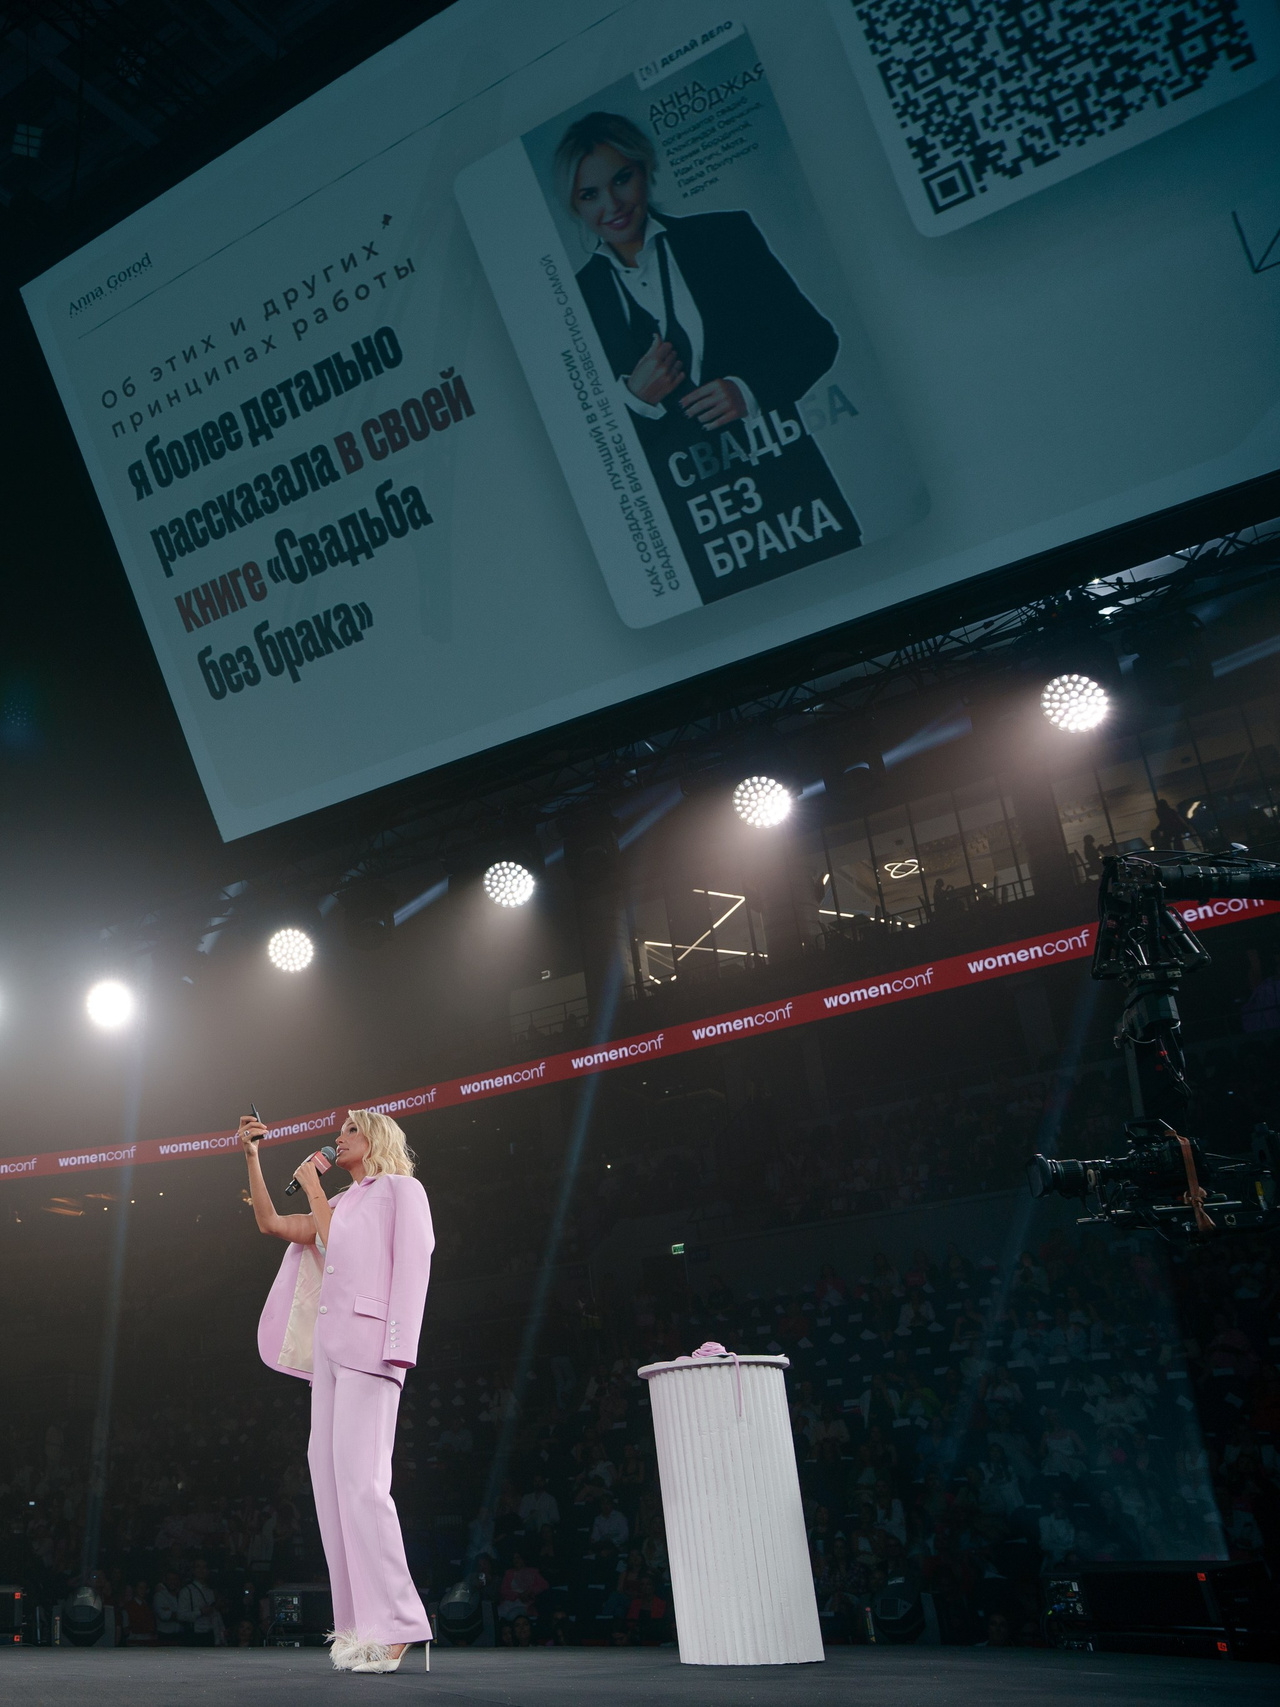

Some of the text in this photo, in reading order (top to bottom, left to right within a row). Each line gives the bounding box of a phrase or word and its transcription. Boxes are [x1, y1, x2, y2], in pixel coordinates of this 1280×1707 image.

[661, 20, 732, 68] ДЕЛАЙ ДЕЛО
[648, 80, 707, 121] АННА
[69, 252, 152, 316] Anna Gorod
[101, 241, 380, 410] Об этих и других
[111, 258, 416, 439] принципах работы
[127, 326, 404, 502] я более детально
[539, 254, 680, 591] СВАДЕБНЫЙ БИЗНЕС И НЕ РАЗВЕСТИСЬ САМОЙ
[149, 366, 476, 579] рассказала в своей
[561, 350, 666, 597] КАК СОЗДАТЬ ЛУЧШИЙ В РОССИИ
[686, 476, 763, 535] БЕЗ
[174, 478, 434, 634] книге «Свадьба
[703, 498, 843, 579] БРАКА
[196, 600, 375, 701] без брака»
[967, 928, 1091, 974] womenconf
[823, 967, 934, 1009] womenconf
[692, 1002, 793, 1041] womenconf
[460, 1062, 546, 1096] womenconf
[571, 1034, 665, 1070] womenconf
[361, 1088, 437, 1114] omenconf
[58, 1145, 137, 1168] womenconf
[159, 1132, 240, 1155] womenconf
